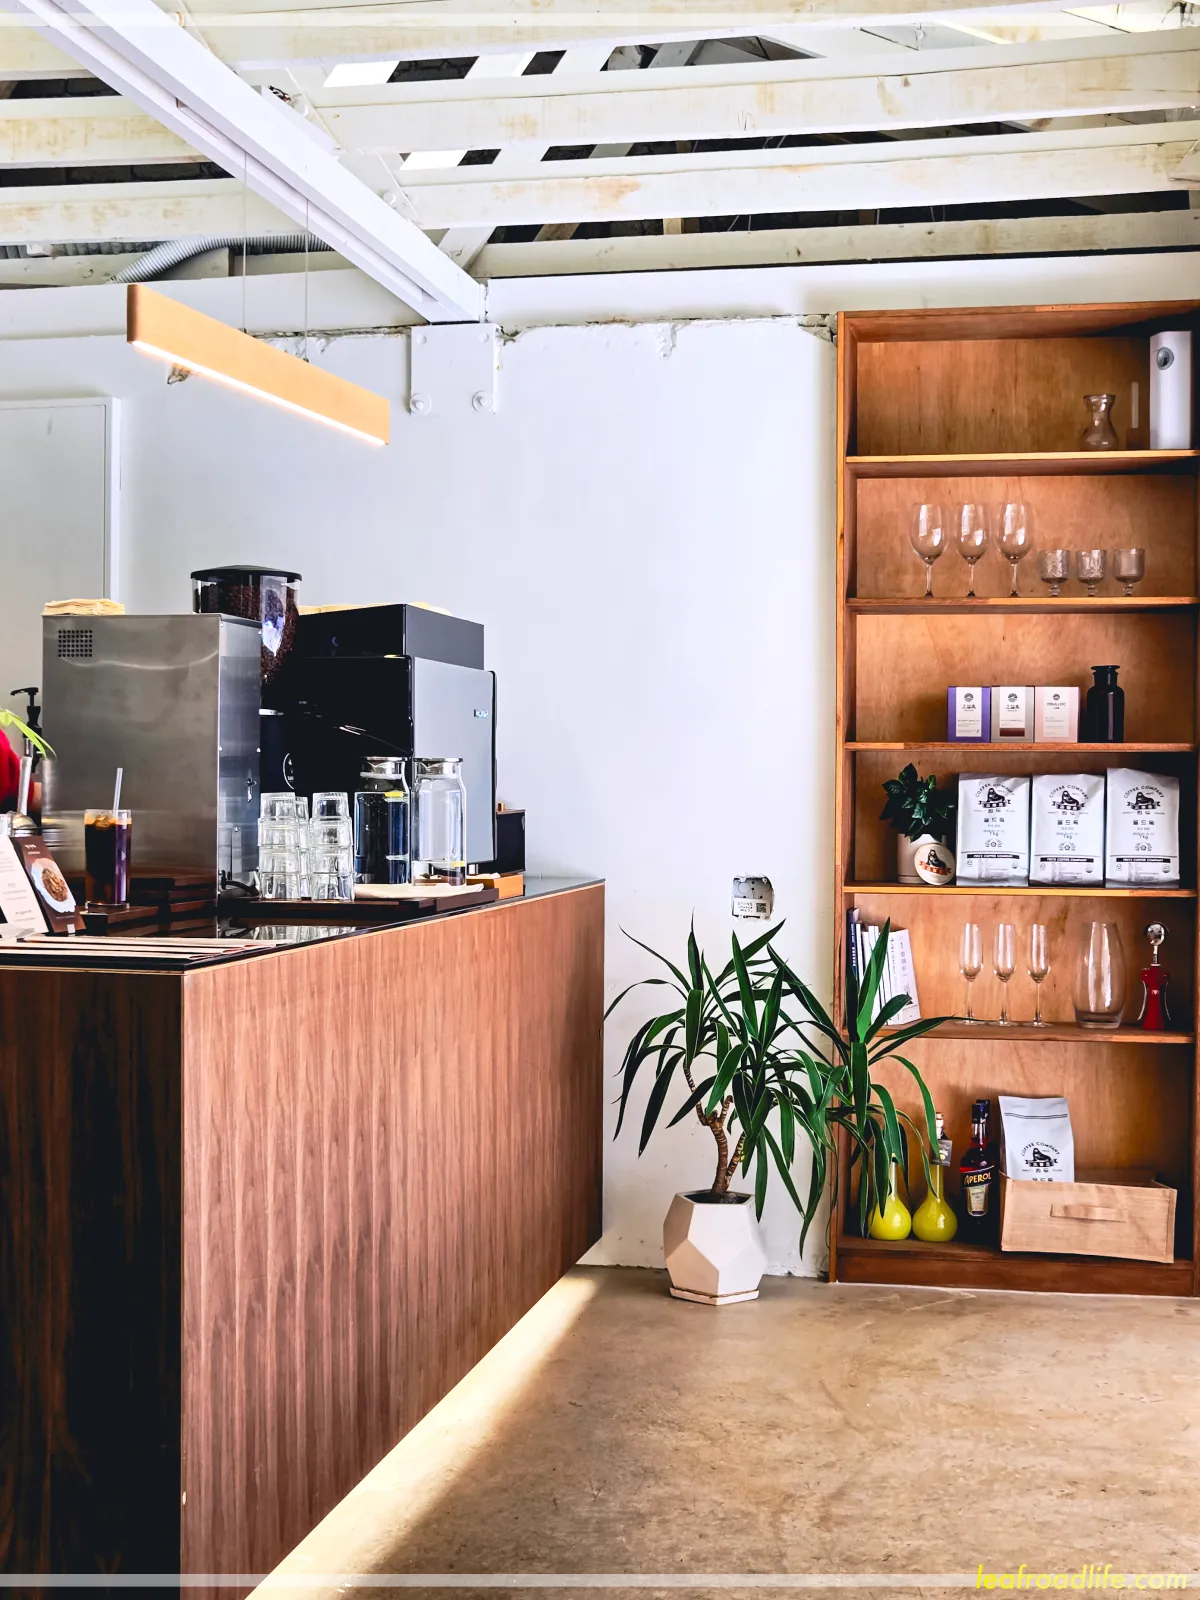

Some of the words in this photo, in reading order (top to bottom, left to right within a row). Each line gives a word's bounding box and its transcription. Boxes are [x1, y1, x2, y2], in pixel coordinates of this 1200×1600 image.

[1140, 785, 1165, 798] COMPANY
[1035, 1141, 1061, 1155] COMPANY
[964, 1172, 992, 1185] APEROL
